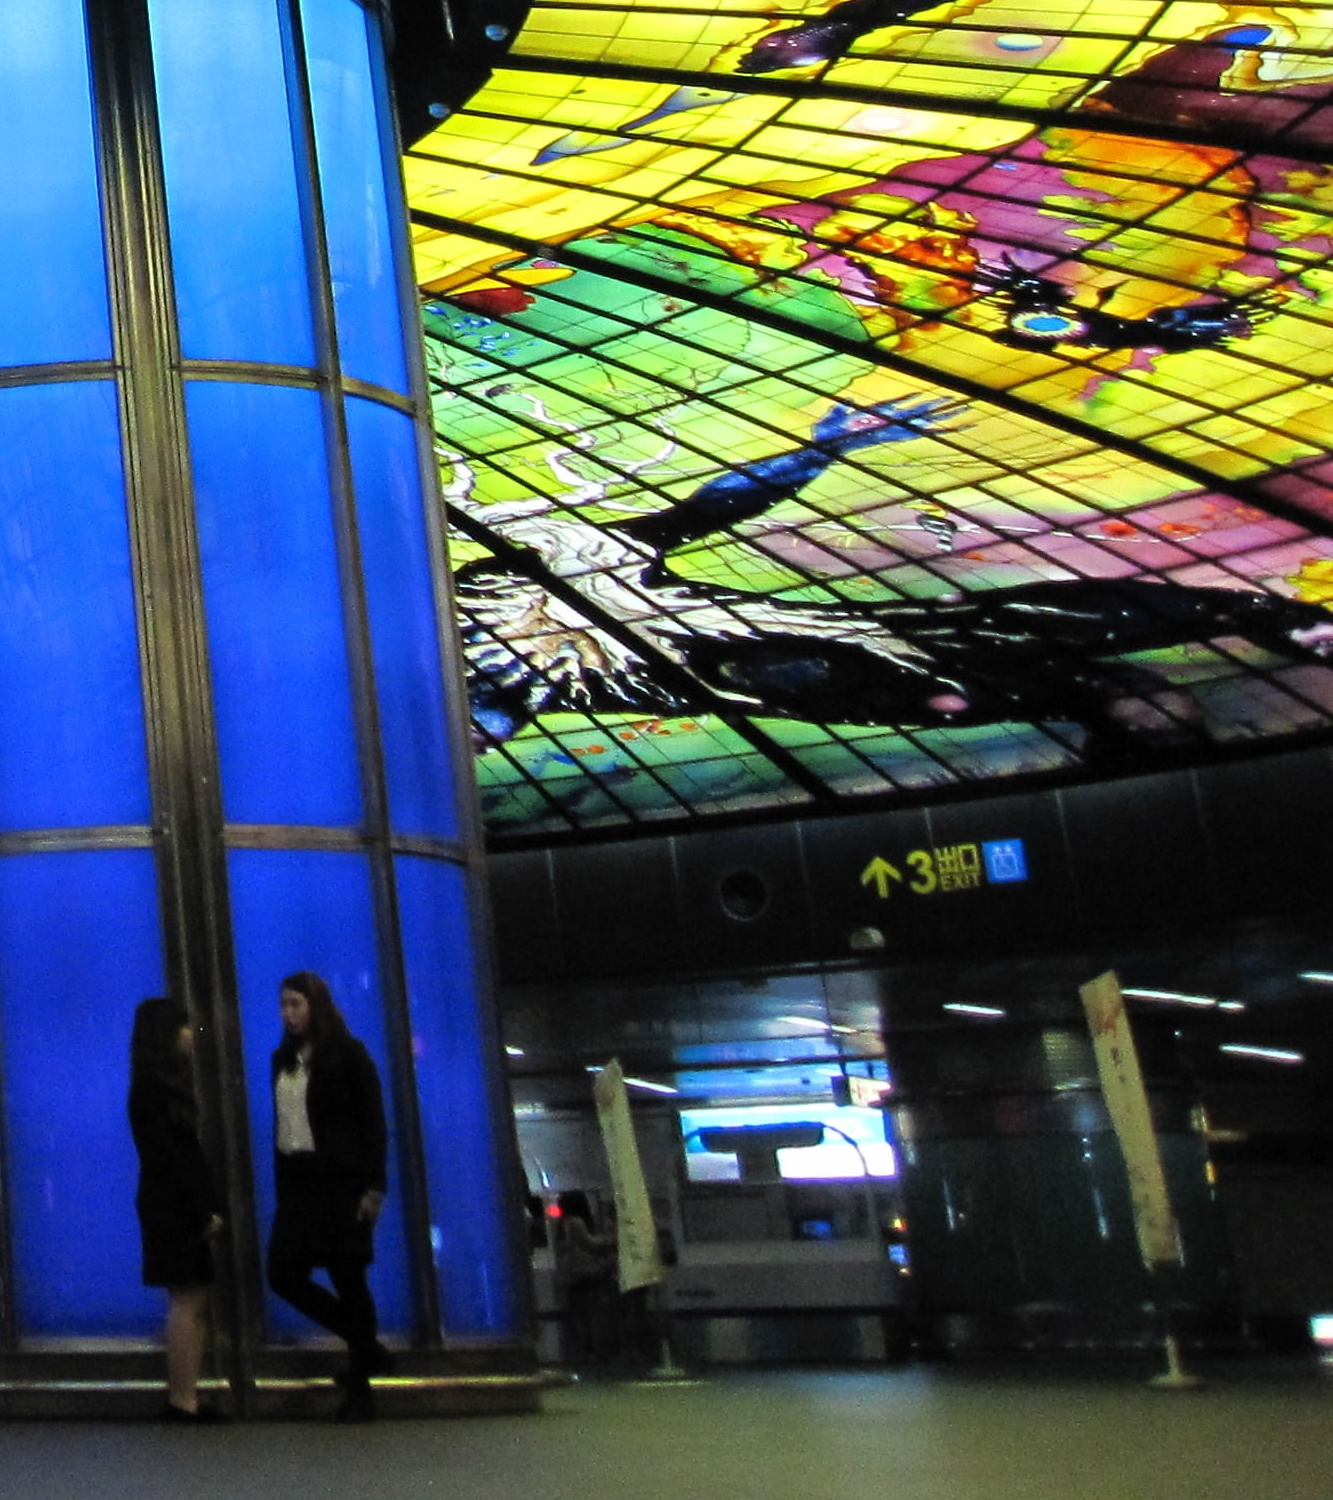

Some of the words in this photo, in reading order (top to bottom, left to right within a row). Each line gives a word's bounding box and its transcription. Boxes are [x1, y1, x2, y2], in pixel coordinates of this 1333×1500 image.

[906, 850, 937, 894] 3
[934, 845, 981, 872] 出口
[939, 872, 980, 891] EXIT
